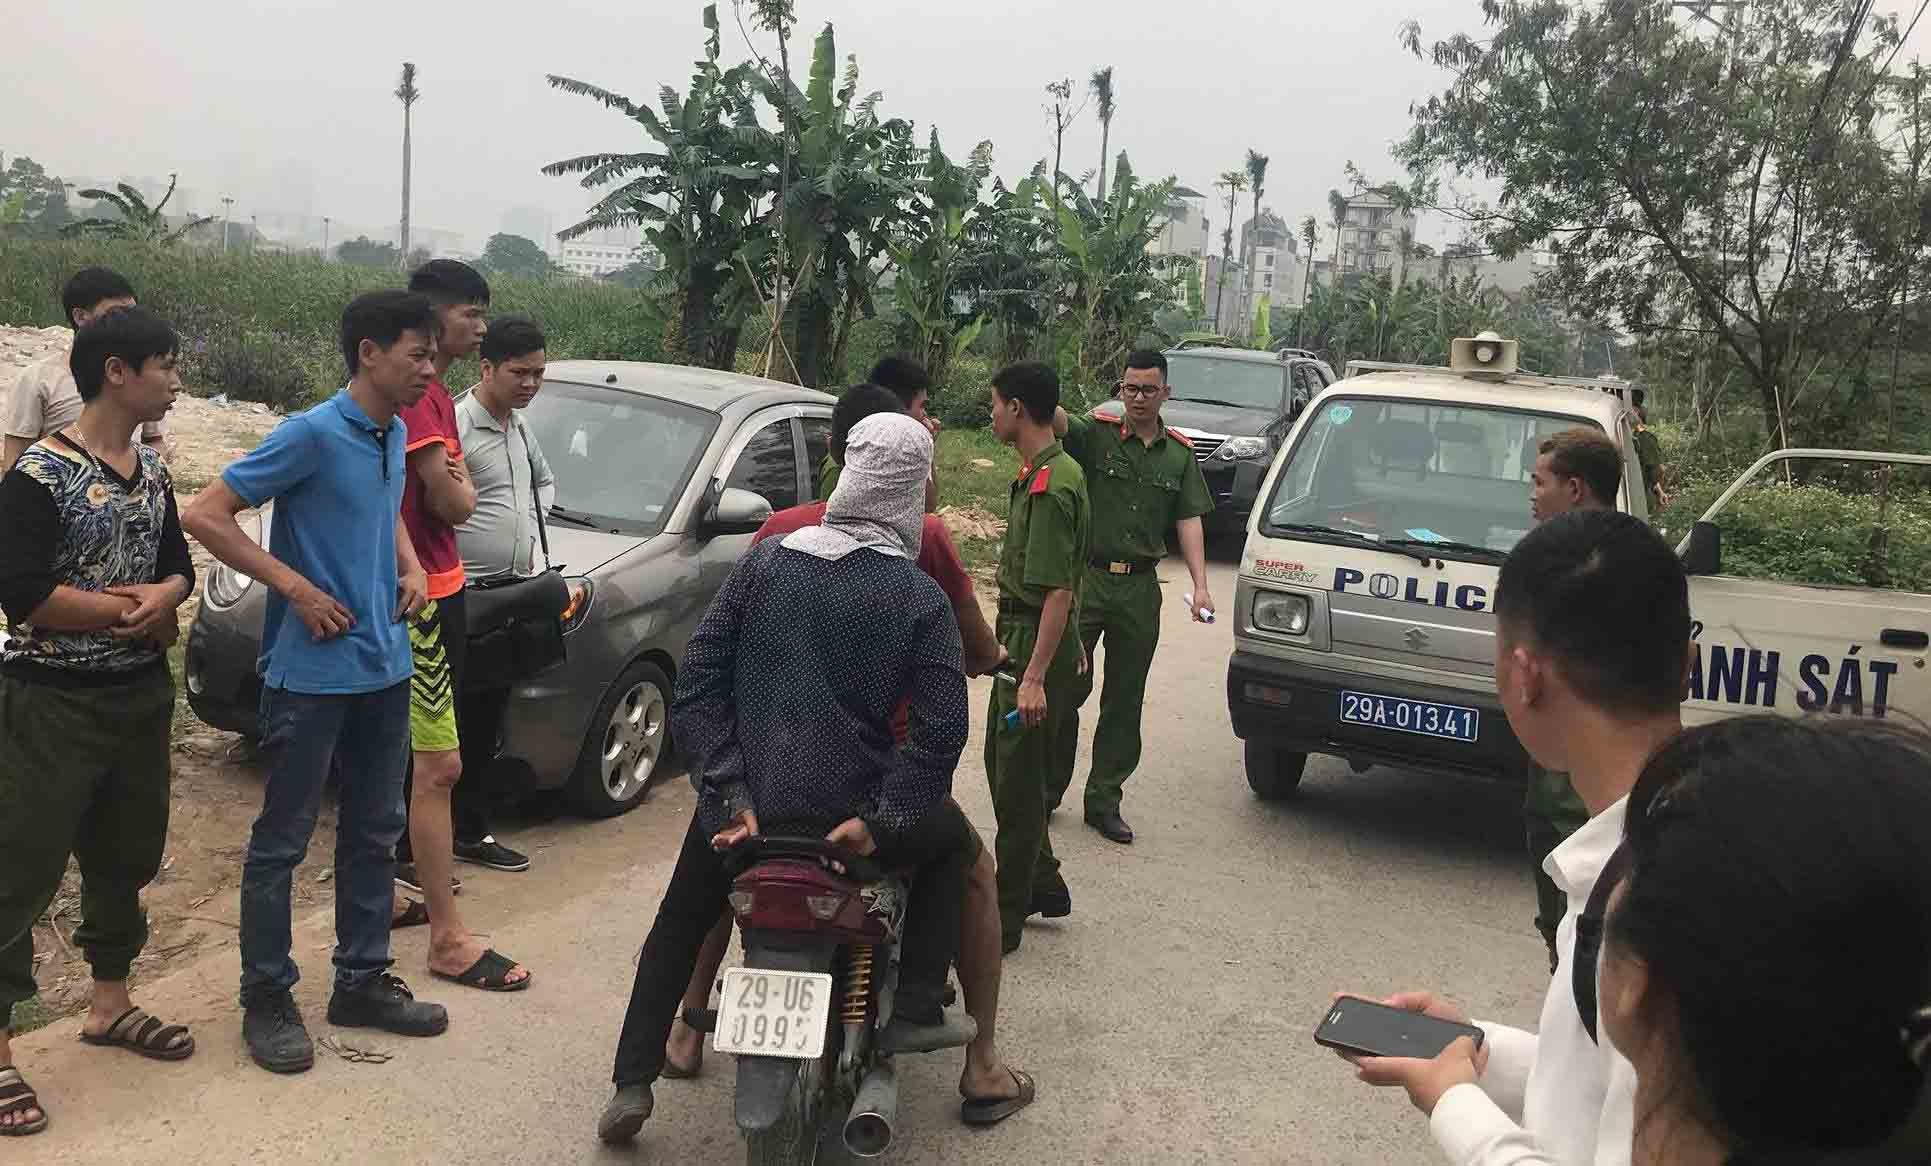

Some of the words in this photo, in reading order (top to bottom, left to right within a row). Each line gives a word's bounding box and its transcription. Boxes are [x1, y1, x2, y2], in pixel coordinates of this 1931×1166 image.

[1252, 566, 1319, 583] CARRY
[1255, 559, 1304, 571] SUPER
[1333, 567, 1488, 611] POLIC
[1686, 620, 1781, 707] ẢNH
[1796, 645, 1898, 718] SÁT
[1345, 695, 1471, 737] 29A-013.41
